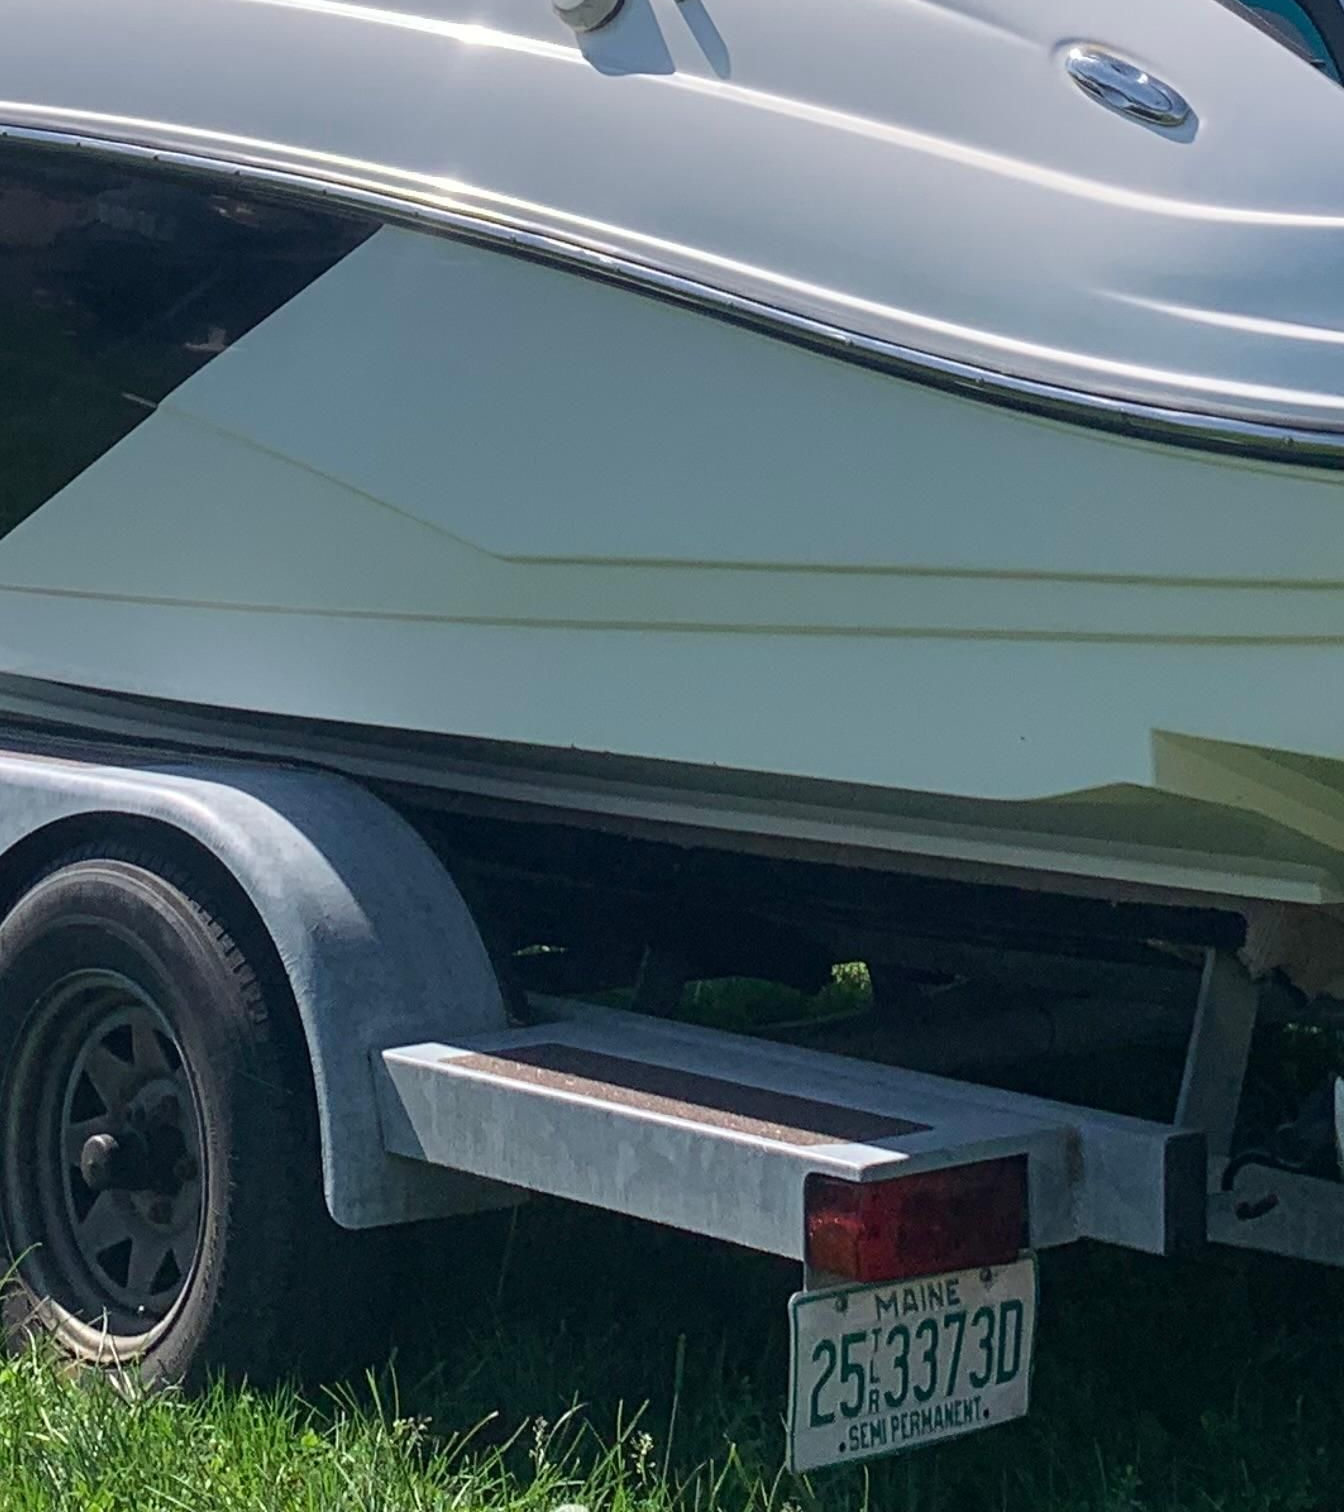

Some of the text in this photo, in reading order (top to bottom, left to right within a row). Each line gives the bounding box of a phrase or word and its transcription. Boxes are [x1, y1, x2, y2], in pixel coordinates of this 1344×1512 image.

[874, 1278, 961, 1321] MAINE
[847, 1395, 982, 1452] SEMI PERMANENT
